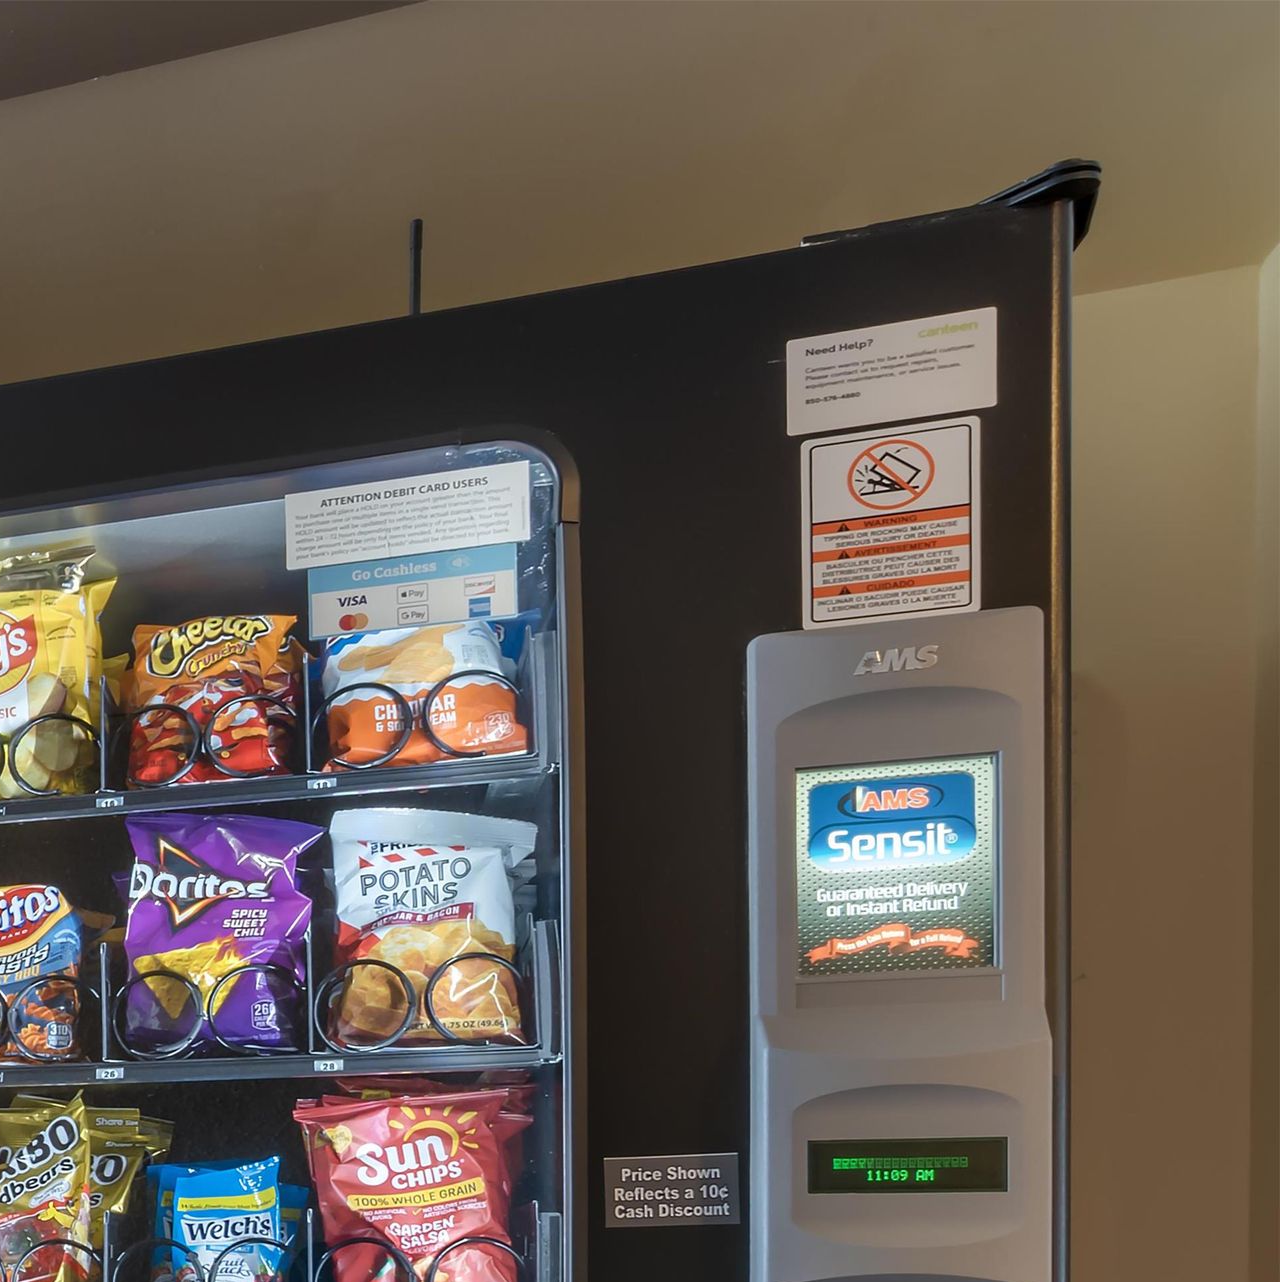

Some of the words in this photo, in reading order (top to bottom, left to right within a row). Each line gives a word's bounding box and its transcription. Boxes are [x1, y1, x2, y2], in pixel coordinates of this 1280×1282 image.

[918, 321, 978, 338] canteen
[805, 345, 836, 356] Need
[839, 339, 874, 351] Help?
[321, 492, 381, 507] ATTENTION
[383, 487, 416, 499] DEBIT
[419, 482, 450, 494] CARD
[453, 477, 488, 489] USERS
[824, 533, 854, 542] TIPPING
[871, 527, 908, 536] ROCKING
[929, 521, 957, 529] CAUSE
[864, 515, 918, 527] WARNING
[836, 539, 870, 548] SERIOUS
[872, 535, 902, 543] INJURY
[917, 529, 945, 538] DEATH
[855, 541, 938, 557] AVERTISSEMENT
[352, 569, 370, 582] Go
[374, 561, 437, 579] Cashless
[408, 588, 425, 598] Pay
[866, 579, 915, 592] CUIDADO
[337, 595, 368, 608] VISA
[150, 615, 271, 675] Cheetos
[185, 642, 248, 678] Crunchy
[854, 645, 939, 676] AMS
[862, 786, 929, 812] AMS
[828, 823, 954, 862] Sensit
[129, 862, 268, 902] Doritos
[360, 857, 471, 896] POTATO
[374, 882, 458, 909] SKINS
[816, 883, 904, 902] Guaranteed
[907, 881, 968, 901] Delivery
[230, 908, 268, 919] SPICY
[427, 906, 460, 921] BACON
[827, 904, 841, 917] or
[846, 901, 900, 915] Instant
[903, 896, 958, 913] Refund
[222, 917, 268, 928] SWEET
[233, 926, 266, 938] CHILI
[356, 1135, 449, 1186] Sun
[391, 1159, 463, 1190] CHIPS
[620, 1167, 662, 1183] Price
[666, 1165, 721, 1181] Shown
[866, 1169, 908, 1182] 11:09
[915, 1169, 934, 1181] AM
[353, 1195, 389, 1209] 100%
[391, 1191, 437, 1205] WHOLE
[439, 1182, 477, 1198] GRAIN
[614, 1185, 680, 1201] Reflects
[685, 1189, 694, 1199] a
[699, 1184, 729, 1201] 10¢
[614, 1203, 655, 1219] Cash
[658, 1201, 730, 1217] Discount
[185, 1216, 270, 1240] Welch's
[388, 1215, 456, 1236] GARDEN
[400, 1229, 449, 1250] SALSA
